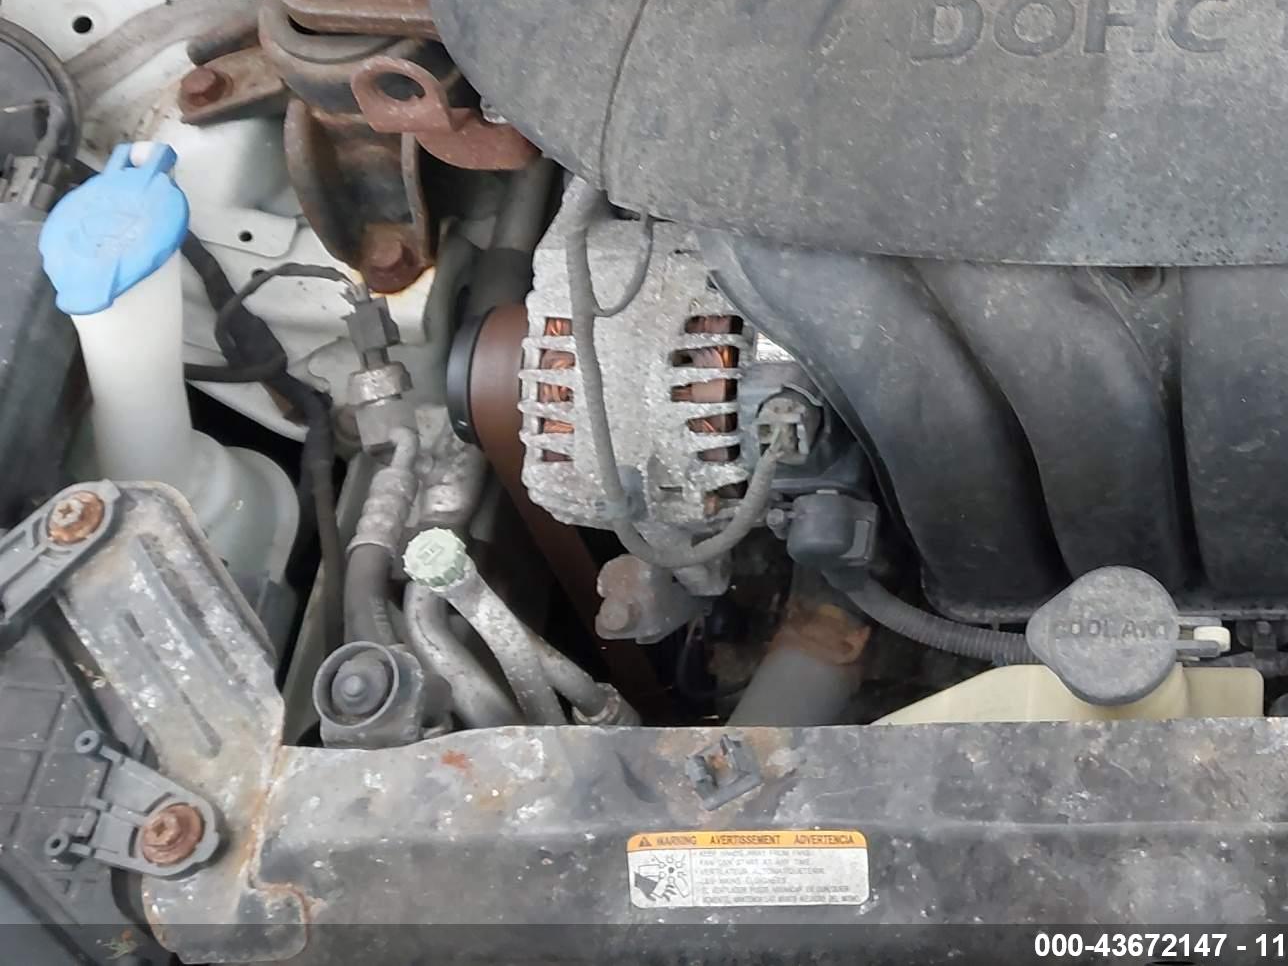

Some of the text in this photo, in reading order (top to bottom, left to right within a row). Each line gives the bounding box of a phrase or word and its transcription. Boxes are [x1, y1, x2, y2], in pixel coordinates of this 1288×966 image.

[1055, 619, 1170, 639] COOLANT
[656, 834, 855, 846] WARNING AVERTISSEMENT ADVERTENCIA
